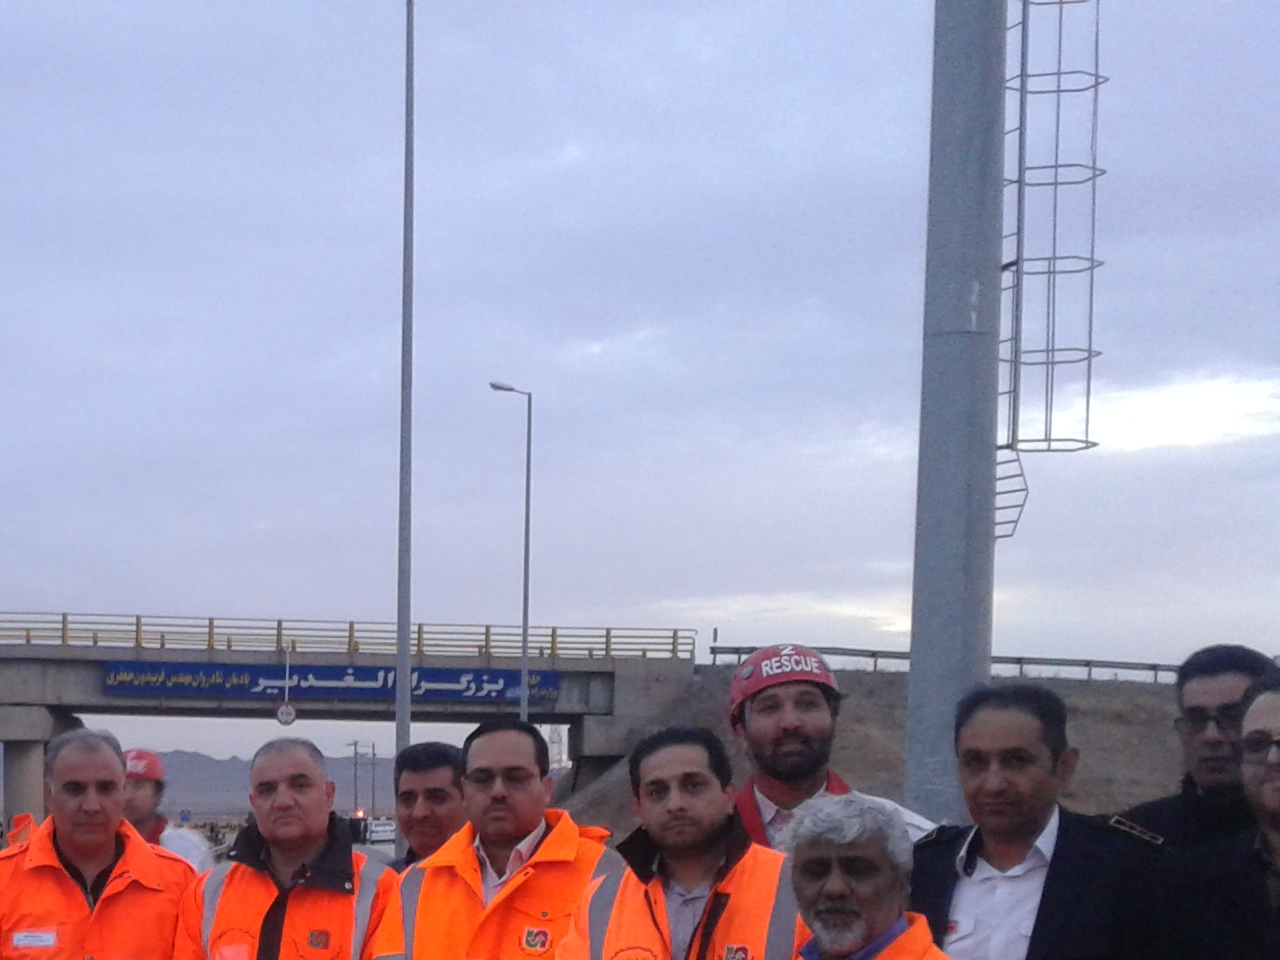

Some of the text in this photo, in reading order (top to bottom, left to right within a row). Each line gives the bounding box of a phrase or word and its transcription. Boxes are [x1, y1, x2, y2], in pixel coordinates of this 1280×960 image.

[778, 645, 796, 655] 2
[761, 655, 821, 677] RESCUE
[251, 667, 395, 694] الغدیر
[400, 670, 504, 696] بزرگرا
